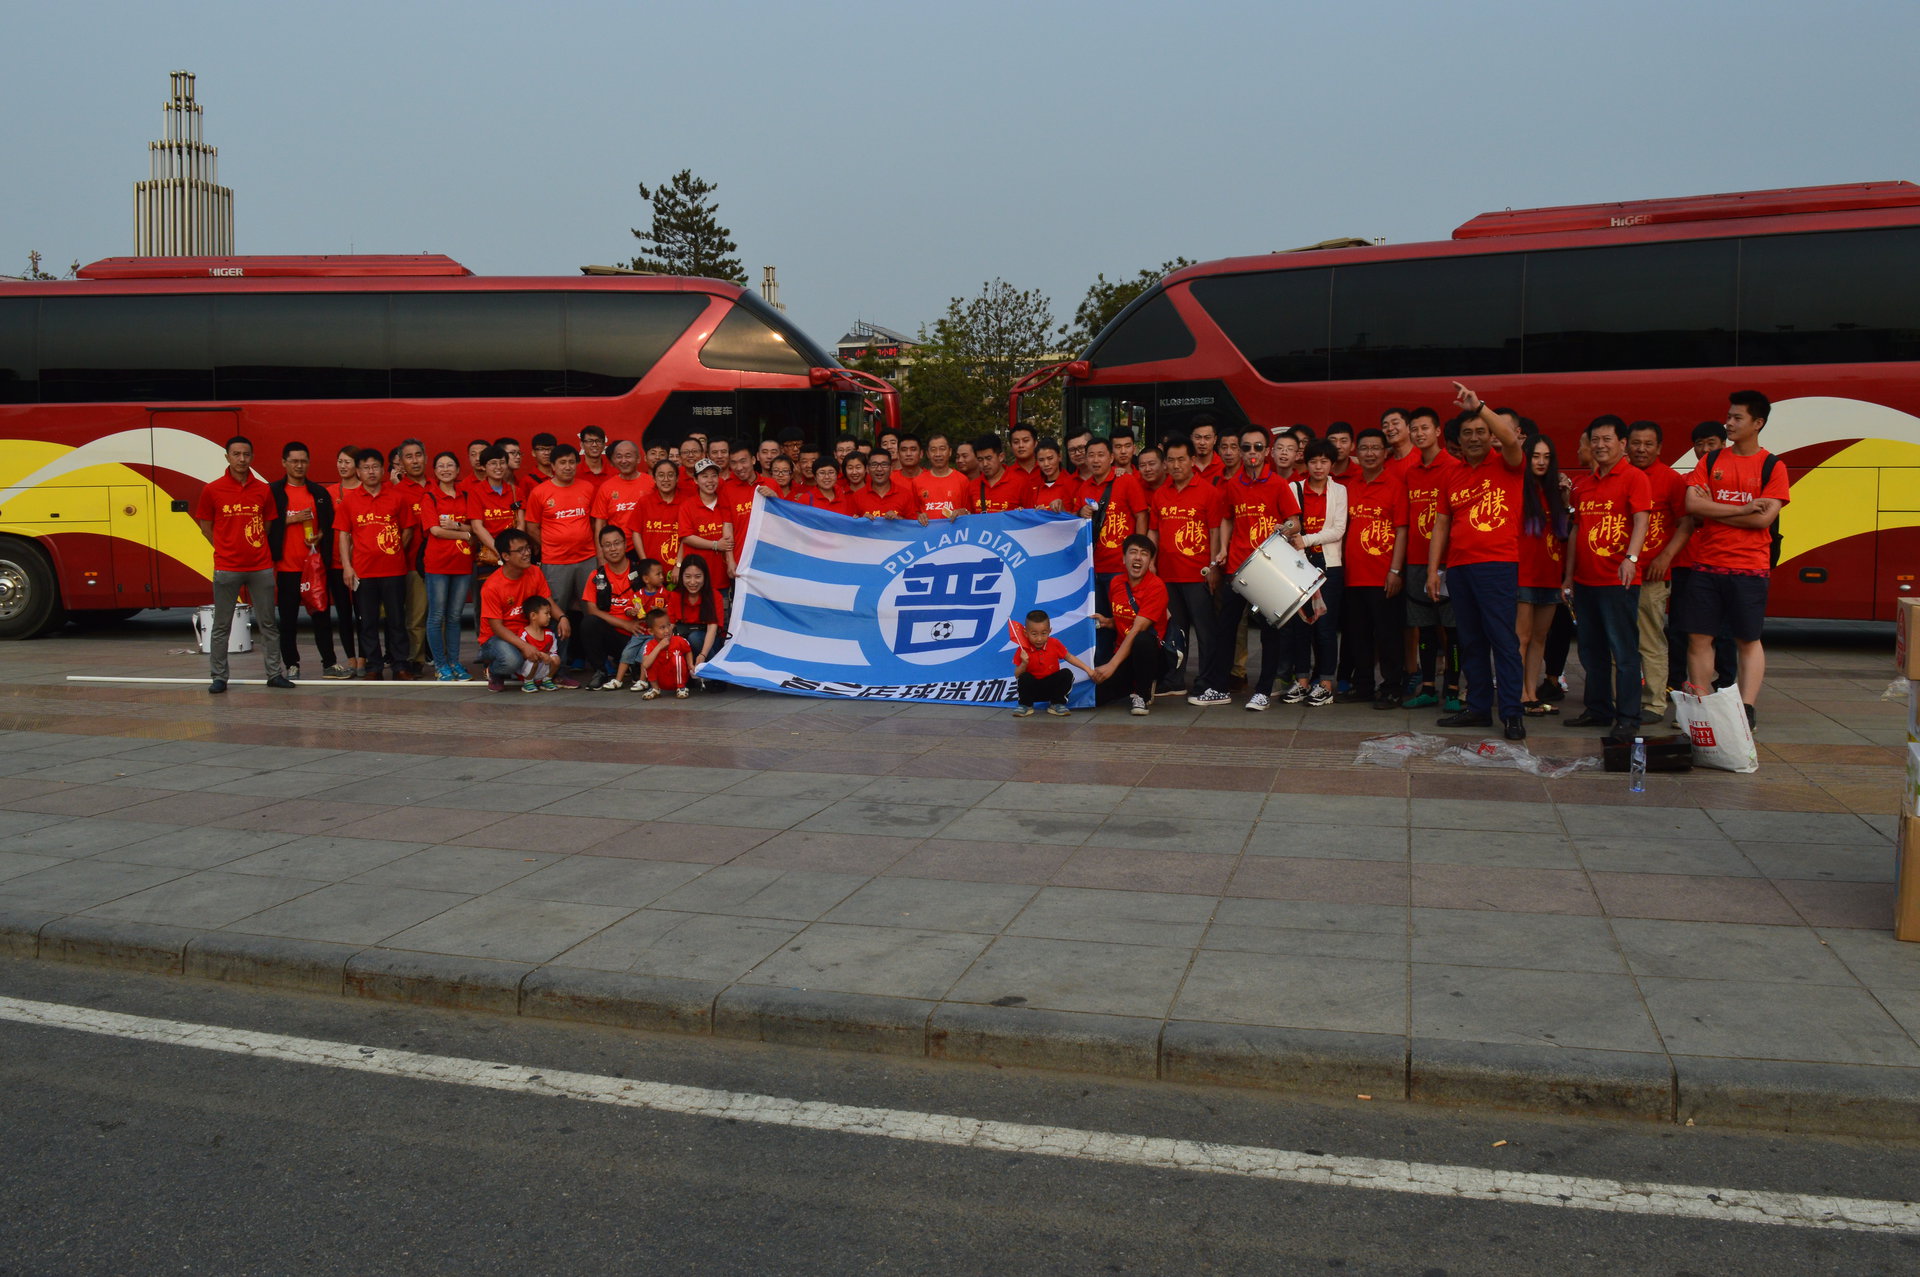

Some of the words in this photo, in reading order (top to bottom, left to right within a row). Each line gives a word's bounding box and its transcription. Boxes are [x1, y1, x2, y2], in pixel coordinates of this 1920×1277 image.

[1611, 214, 1653, 227] HIGER
[208, 268, 244, 277] HIGER
[616, 502, 637, 512] 龙之
[884, 550, 915, 575] PU
[923, 527, 970, 553] LAN
[977, 530, 1026, 569] DIAN
